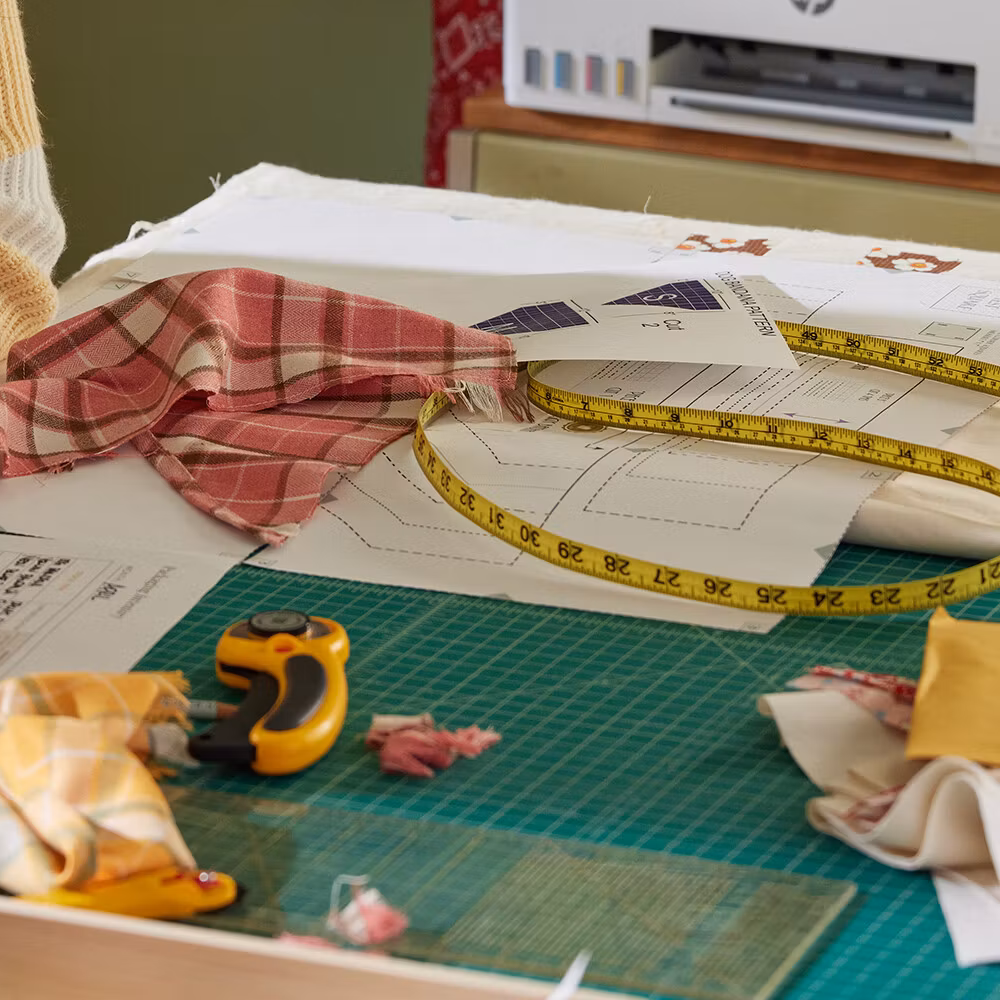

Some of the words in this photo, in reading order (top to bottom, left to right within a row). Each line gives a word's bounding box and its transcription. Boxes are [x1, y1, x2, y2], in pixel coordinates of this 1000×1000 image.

[643, 293, 677, 301] S
[725, 281, 756, 306] BANDANA
[744, 306, 776, 336] PATTERN
[801, 331, 818, 341] 49
[846, 338, 861, 349] 50
[888, 347, 899, 357] 51
[928, 356, 944, 368] 52
[968, 366, 983, 377] 53
[581, 400, 589, 410] 7
[624, 408, 632, 417] 8
[671, 413, 680, 422] 9
[721, 419, 733, 429] 10
[768, 424, 778, 434] 11
[814, 431, 828, 441] 12
[857, 439, 870, 450] 13
[899, 448, 912, 459] 14
[942, 458, 954, 468] 15
[982, 469, 993, 480] 16
[427, 453, 435, 475] 34
[441, 470, 451, 492] 33
[459, 487, 475, 511] 32
[489, 507, 504, 530] 31
[520, 525, 540, 547] 30
[558, 542, 583, 563] 29
[604, 555, 631, 576] 28
[653, 568, 680, 587] 27
[704, 578, 733, 598] 26
[757, 587, 786, 606] 25
[812, 591, 844, 607] 24
[870, 588, 900, 606] 23
[926, 578, 956, 599] 22
[979, 562, 1000, 584] 21
